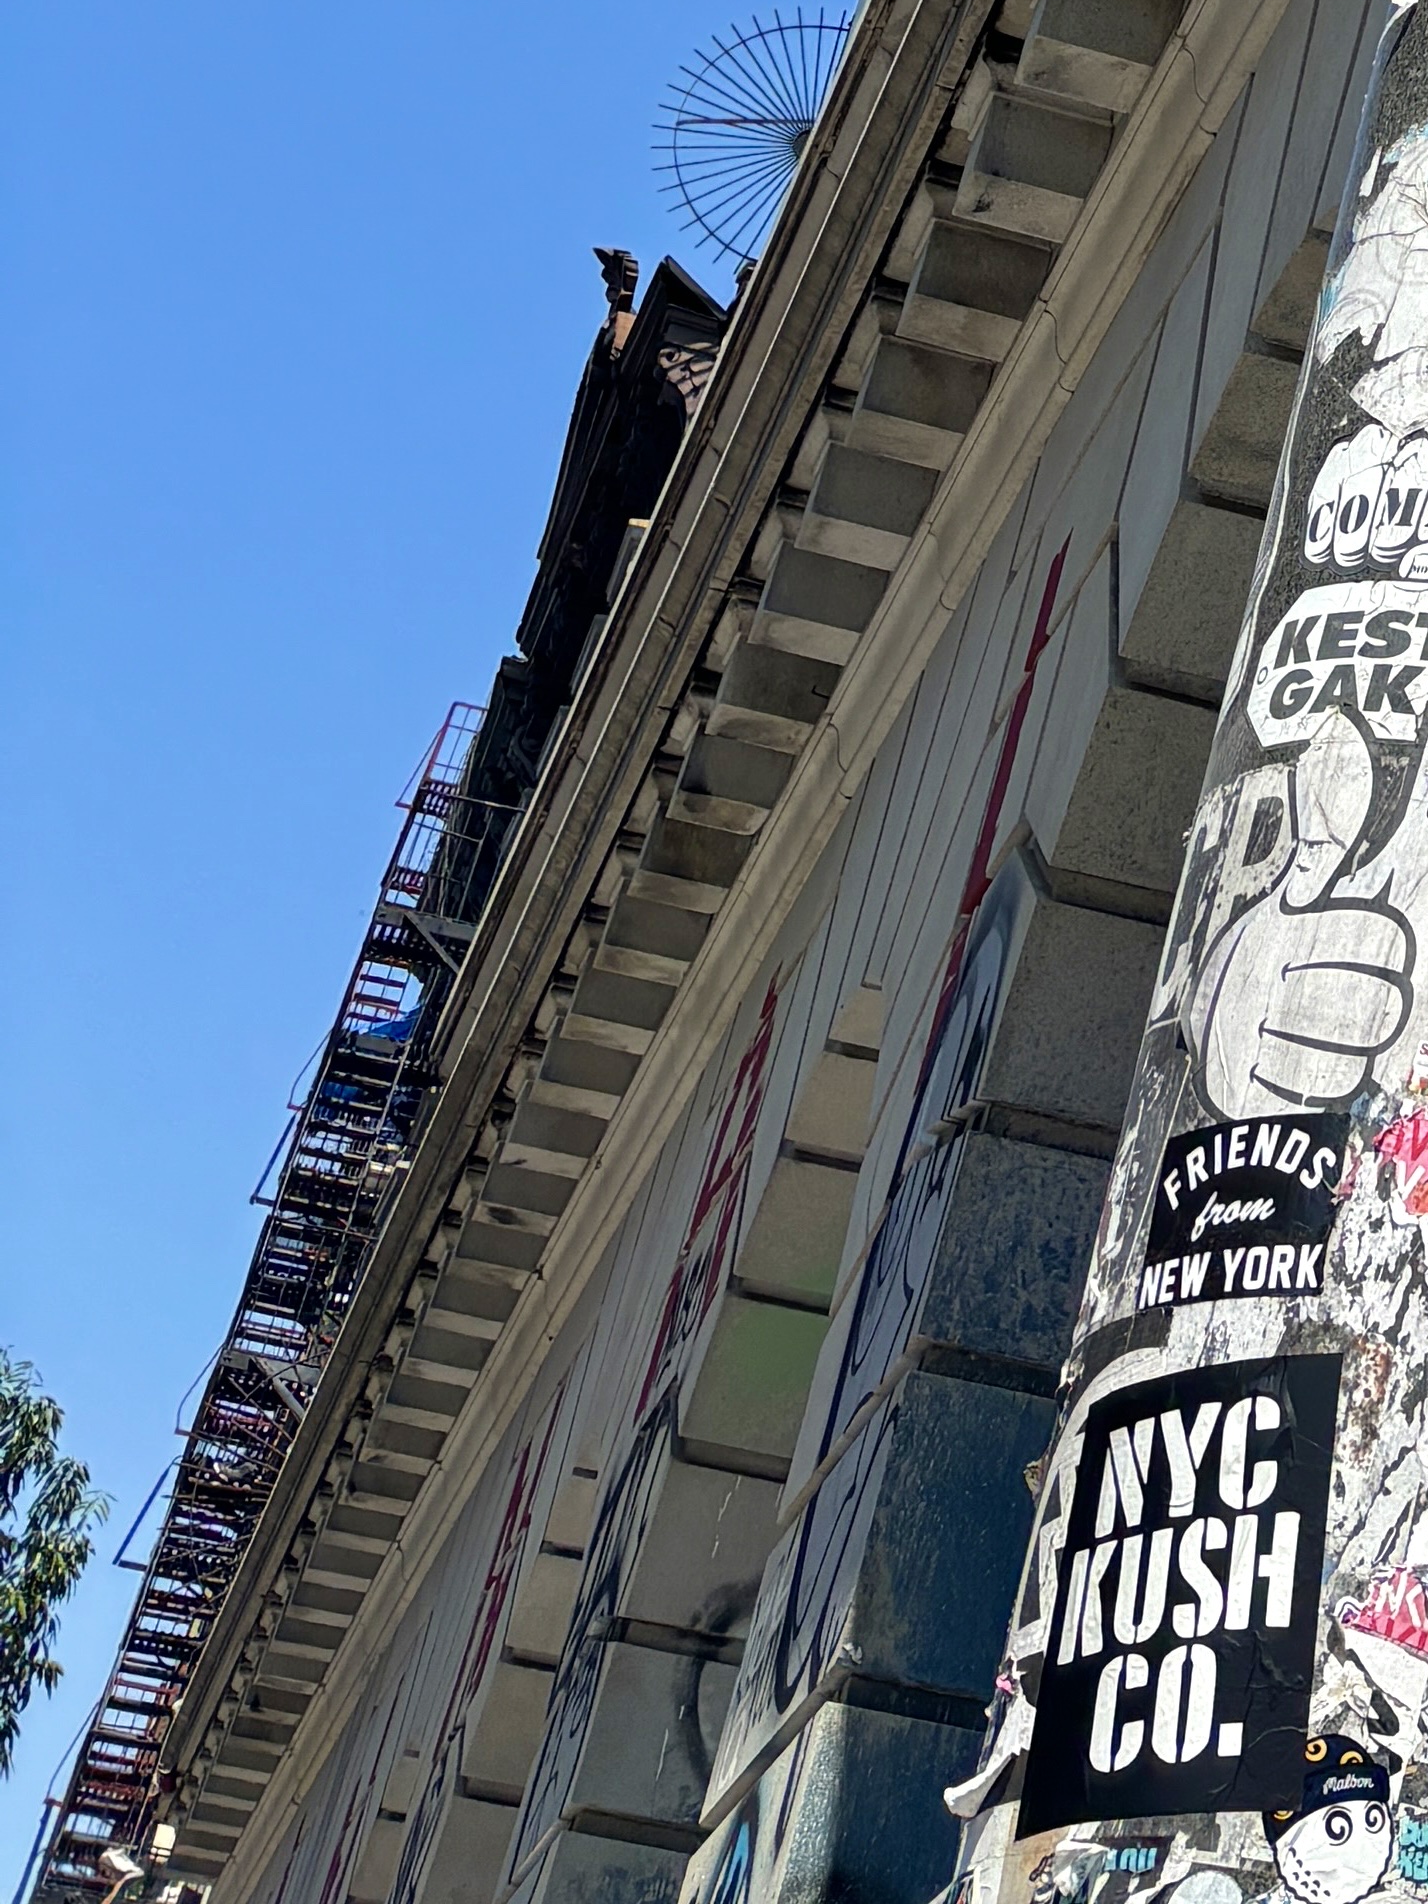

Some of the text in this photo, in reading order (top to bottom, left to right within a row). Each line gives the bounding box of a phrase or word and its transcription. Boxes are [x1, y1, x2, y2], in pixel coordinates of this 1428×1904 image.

[1269, 663, 1426, 720] GAK
[1162, 1123, 1337, 1211] FRIENDS
[1190, 1190, 1276, 1242] from
[1138, 1243, 1324, 1310] NEW YORK
[1094, 1394, 1282, 1541] NYC
[1056, 1511, 1302, 1667] KUSH
[1087, 1642, 1246, 1775] CO.
[1322, 1772, 1375, 1796] Malbon
